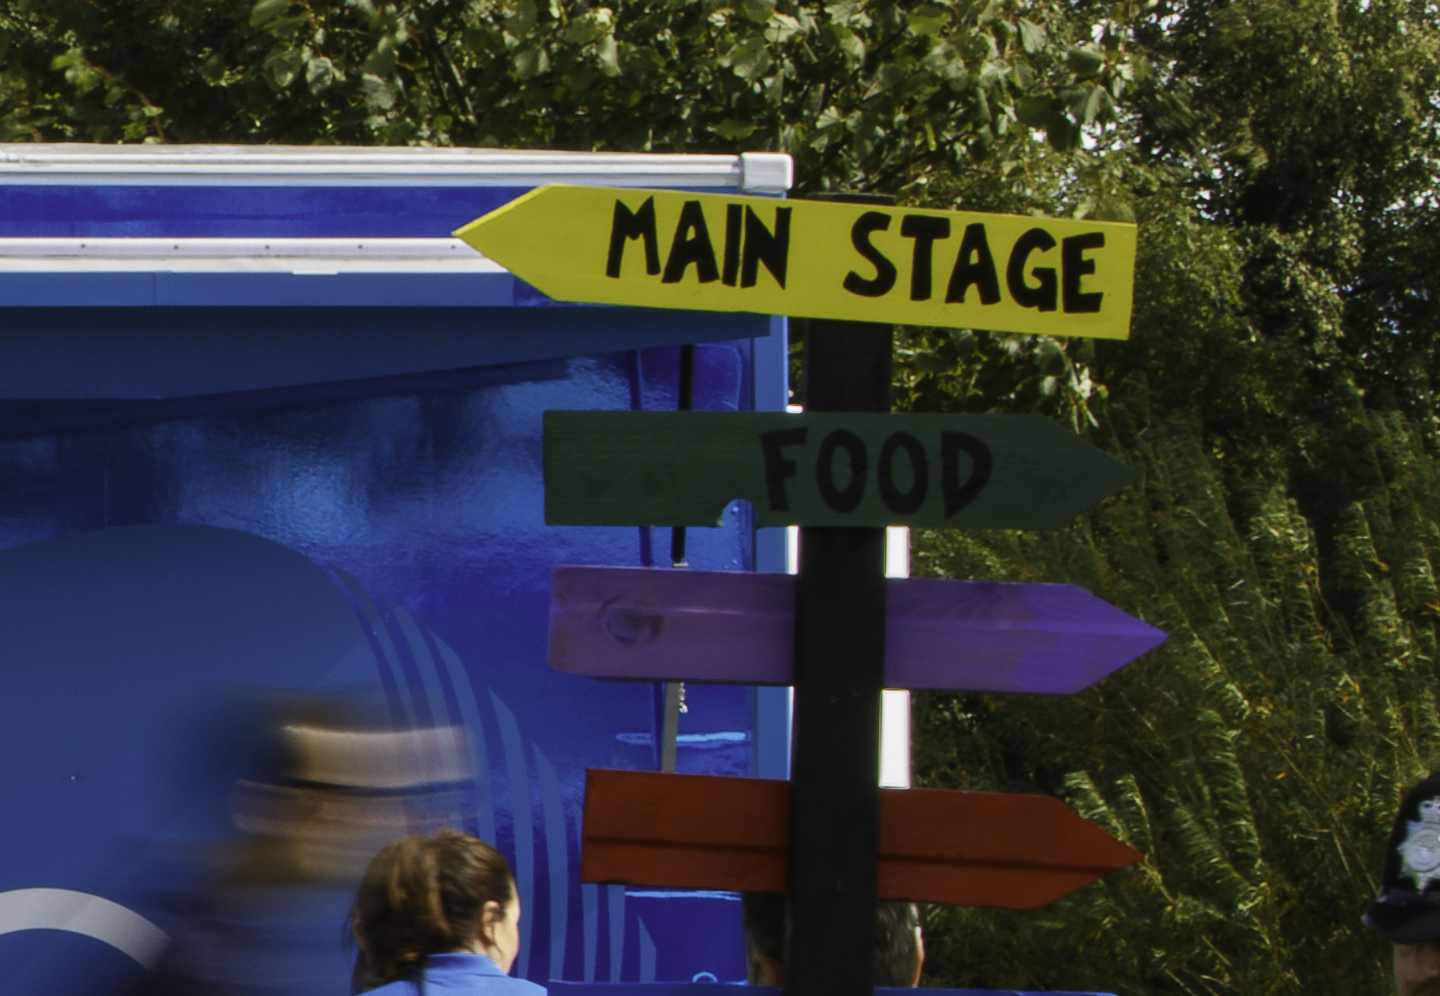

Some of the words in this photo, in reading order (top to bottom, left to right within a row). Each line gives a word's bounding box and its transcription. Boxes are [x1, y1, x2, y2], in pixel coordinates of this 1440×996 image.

[605, 196, 792, 290] MAIN
[842, 211, 1106, 314] STAGE
[759, 426, 993, 519] FOOD
